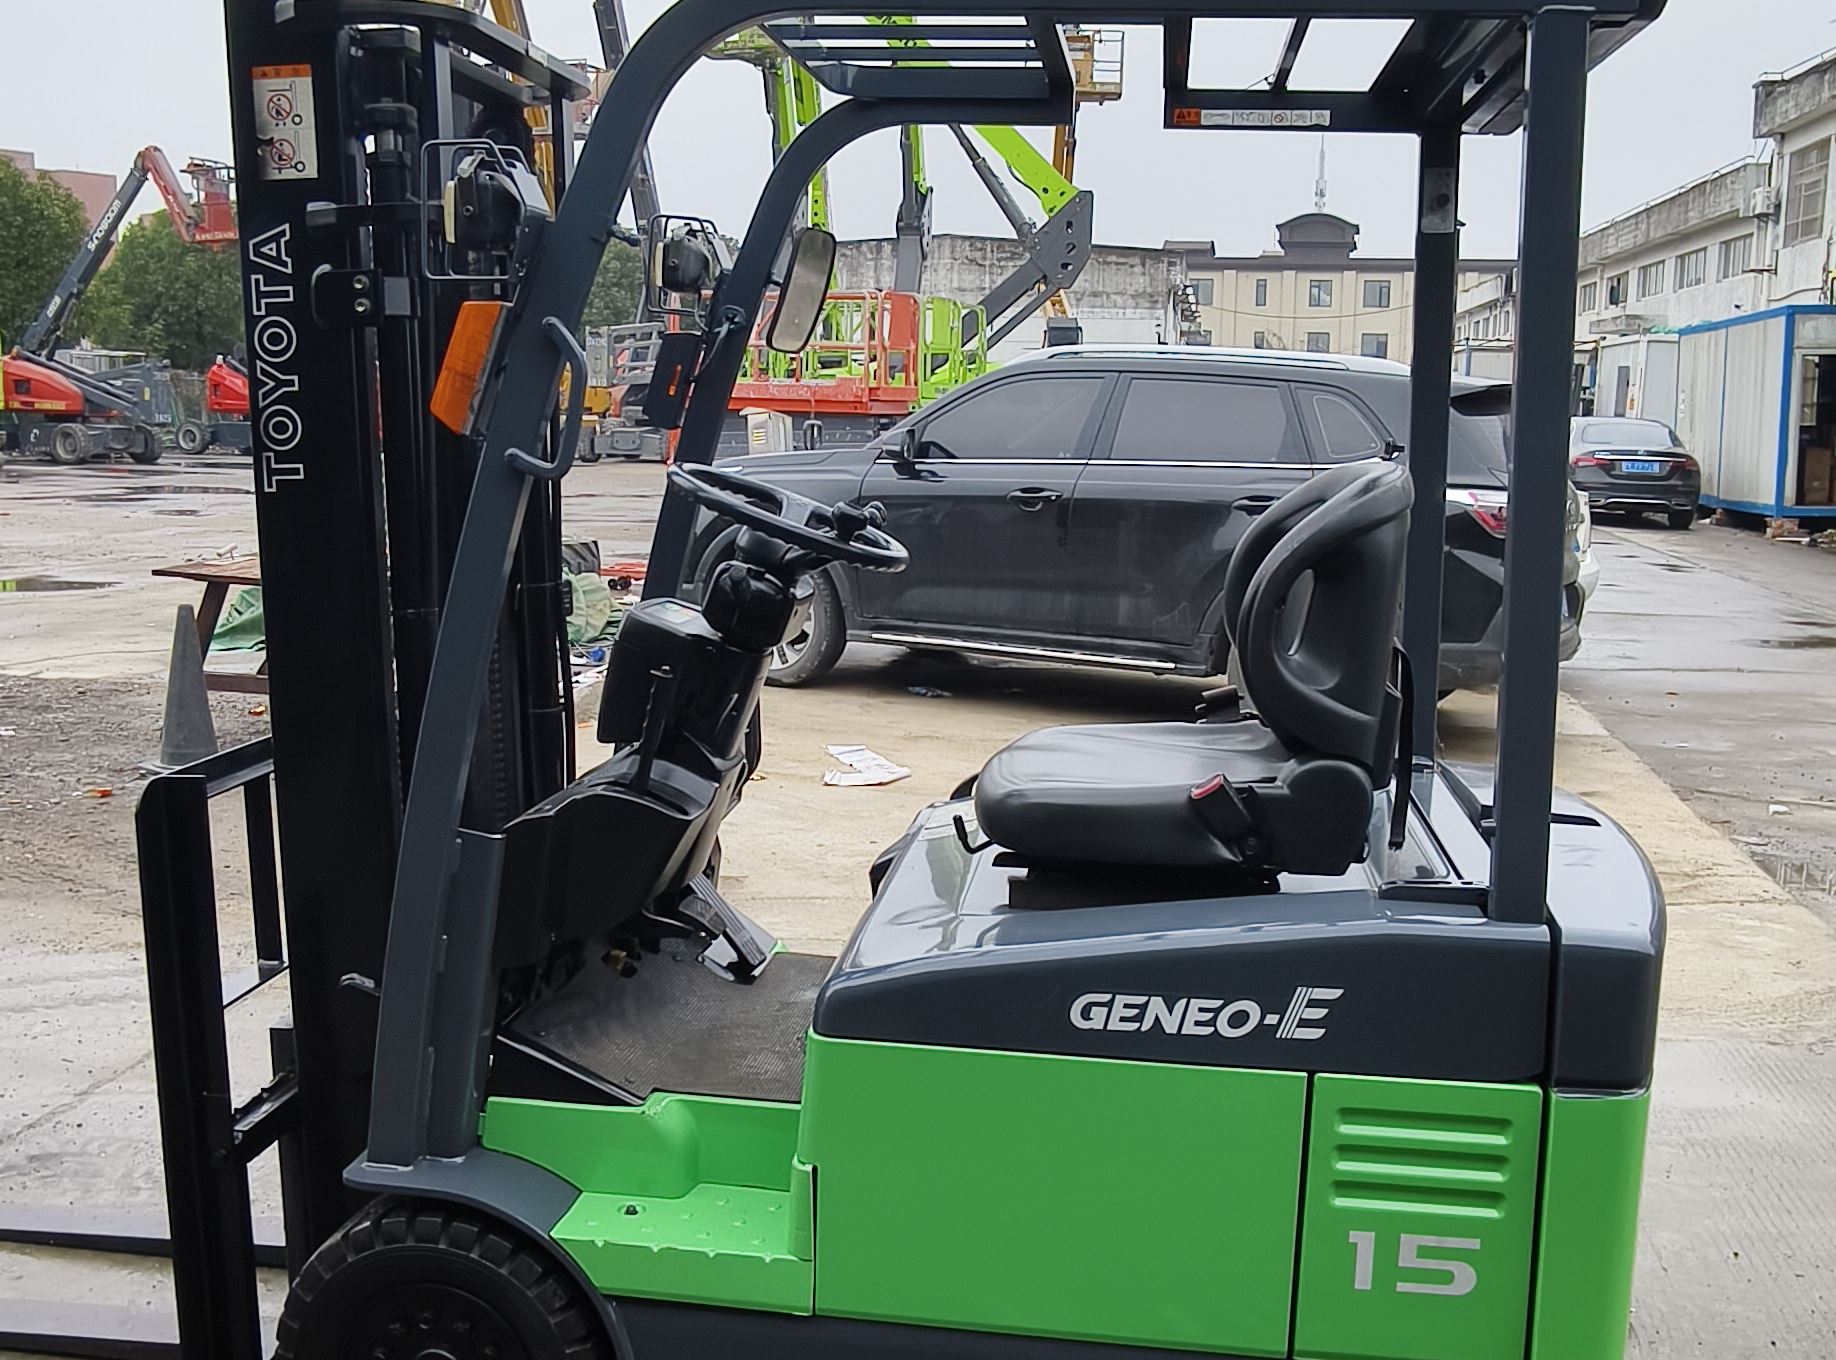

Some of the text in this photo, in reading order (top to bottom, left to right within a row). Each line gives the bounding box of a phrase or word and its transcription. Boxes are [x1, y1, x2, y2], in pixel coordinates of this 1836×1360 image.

[249, 223, 304, 492] TOYOTA
[1069, 987, 1345, 1040] GENEO-E
[1348, 1230, 1481, 1296] 15
